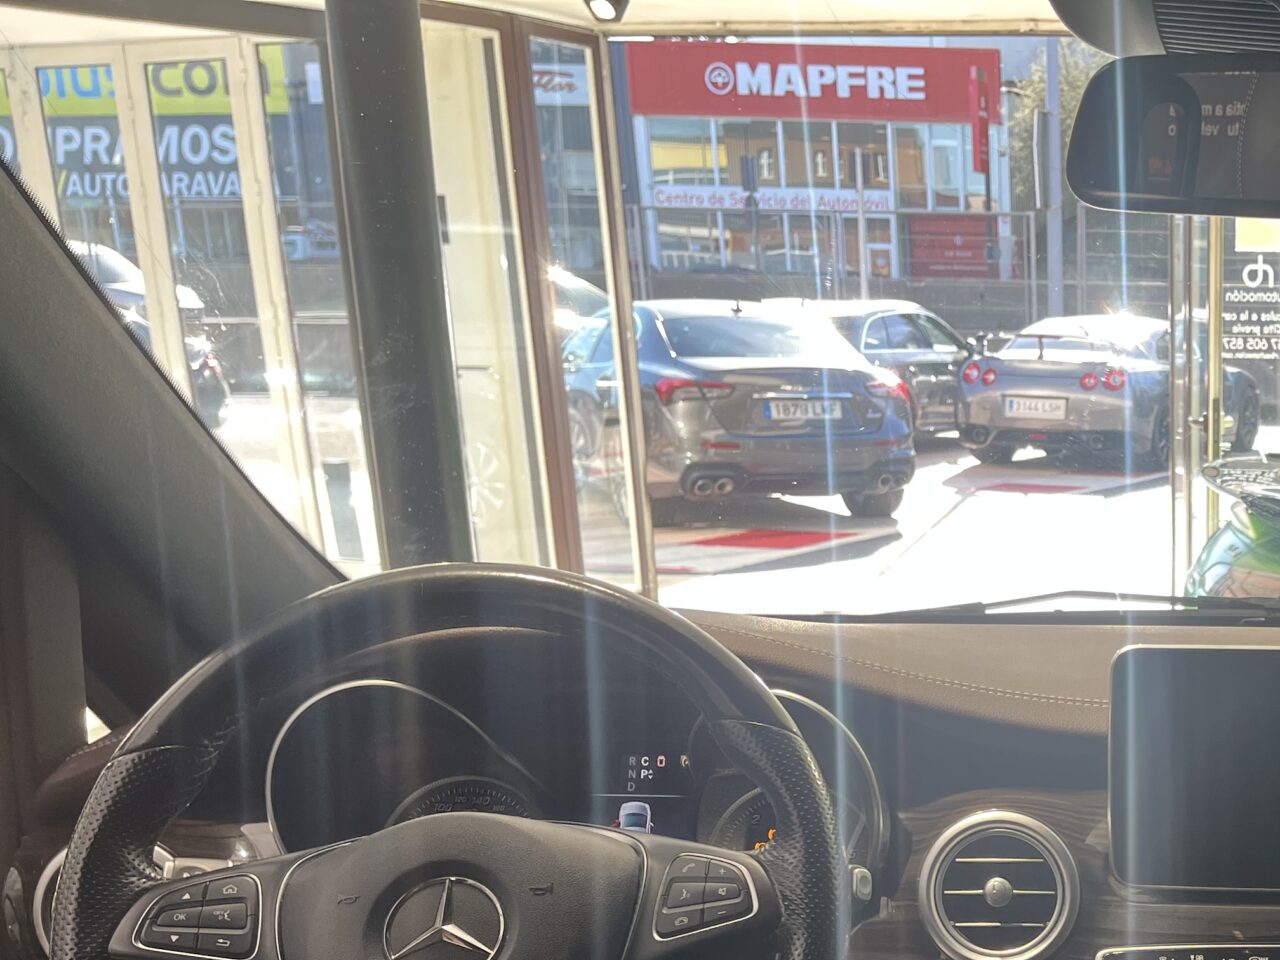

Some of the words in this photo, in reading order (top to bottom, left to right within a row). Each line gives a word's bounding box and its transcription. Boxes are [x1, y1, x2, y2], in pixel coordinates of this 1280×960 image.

[735, 62, 926, 100] MAPFRE
[655, 190, 704, 206] Centro
[708, 191, 725, 207] de
[629, 757, 636, 766] R
[641, 756, 649, 766] C
[628, 770, 636, 779] N
[641, 769, 648, 779] P
[627, 782, 635, 791] D
[751, 814, 760, 824] 2
